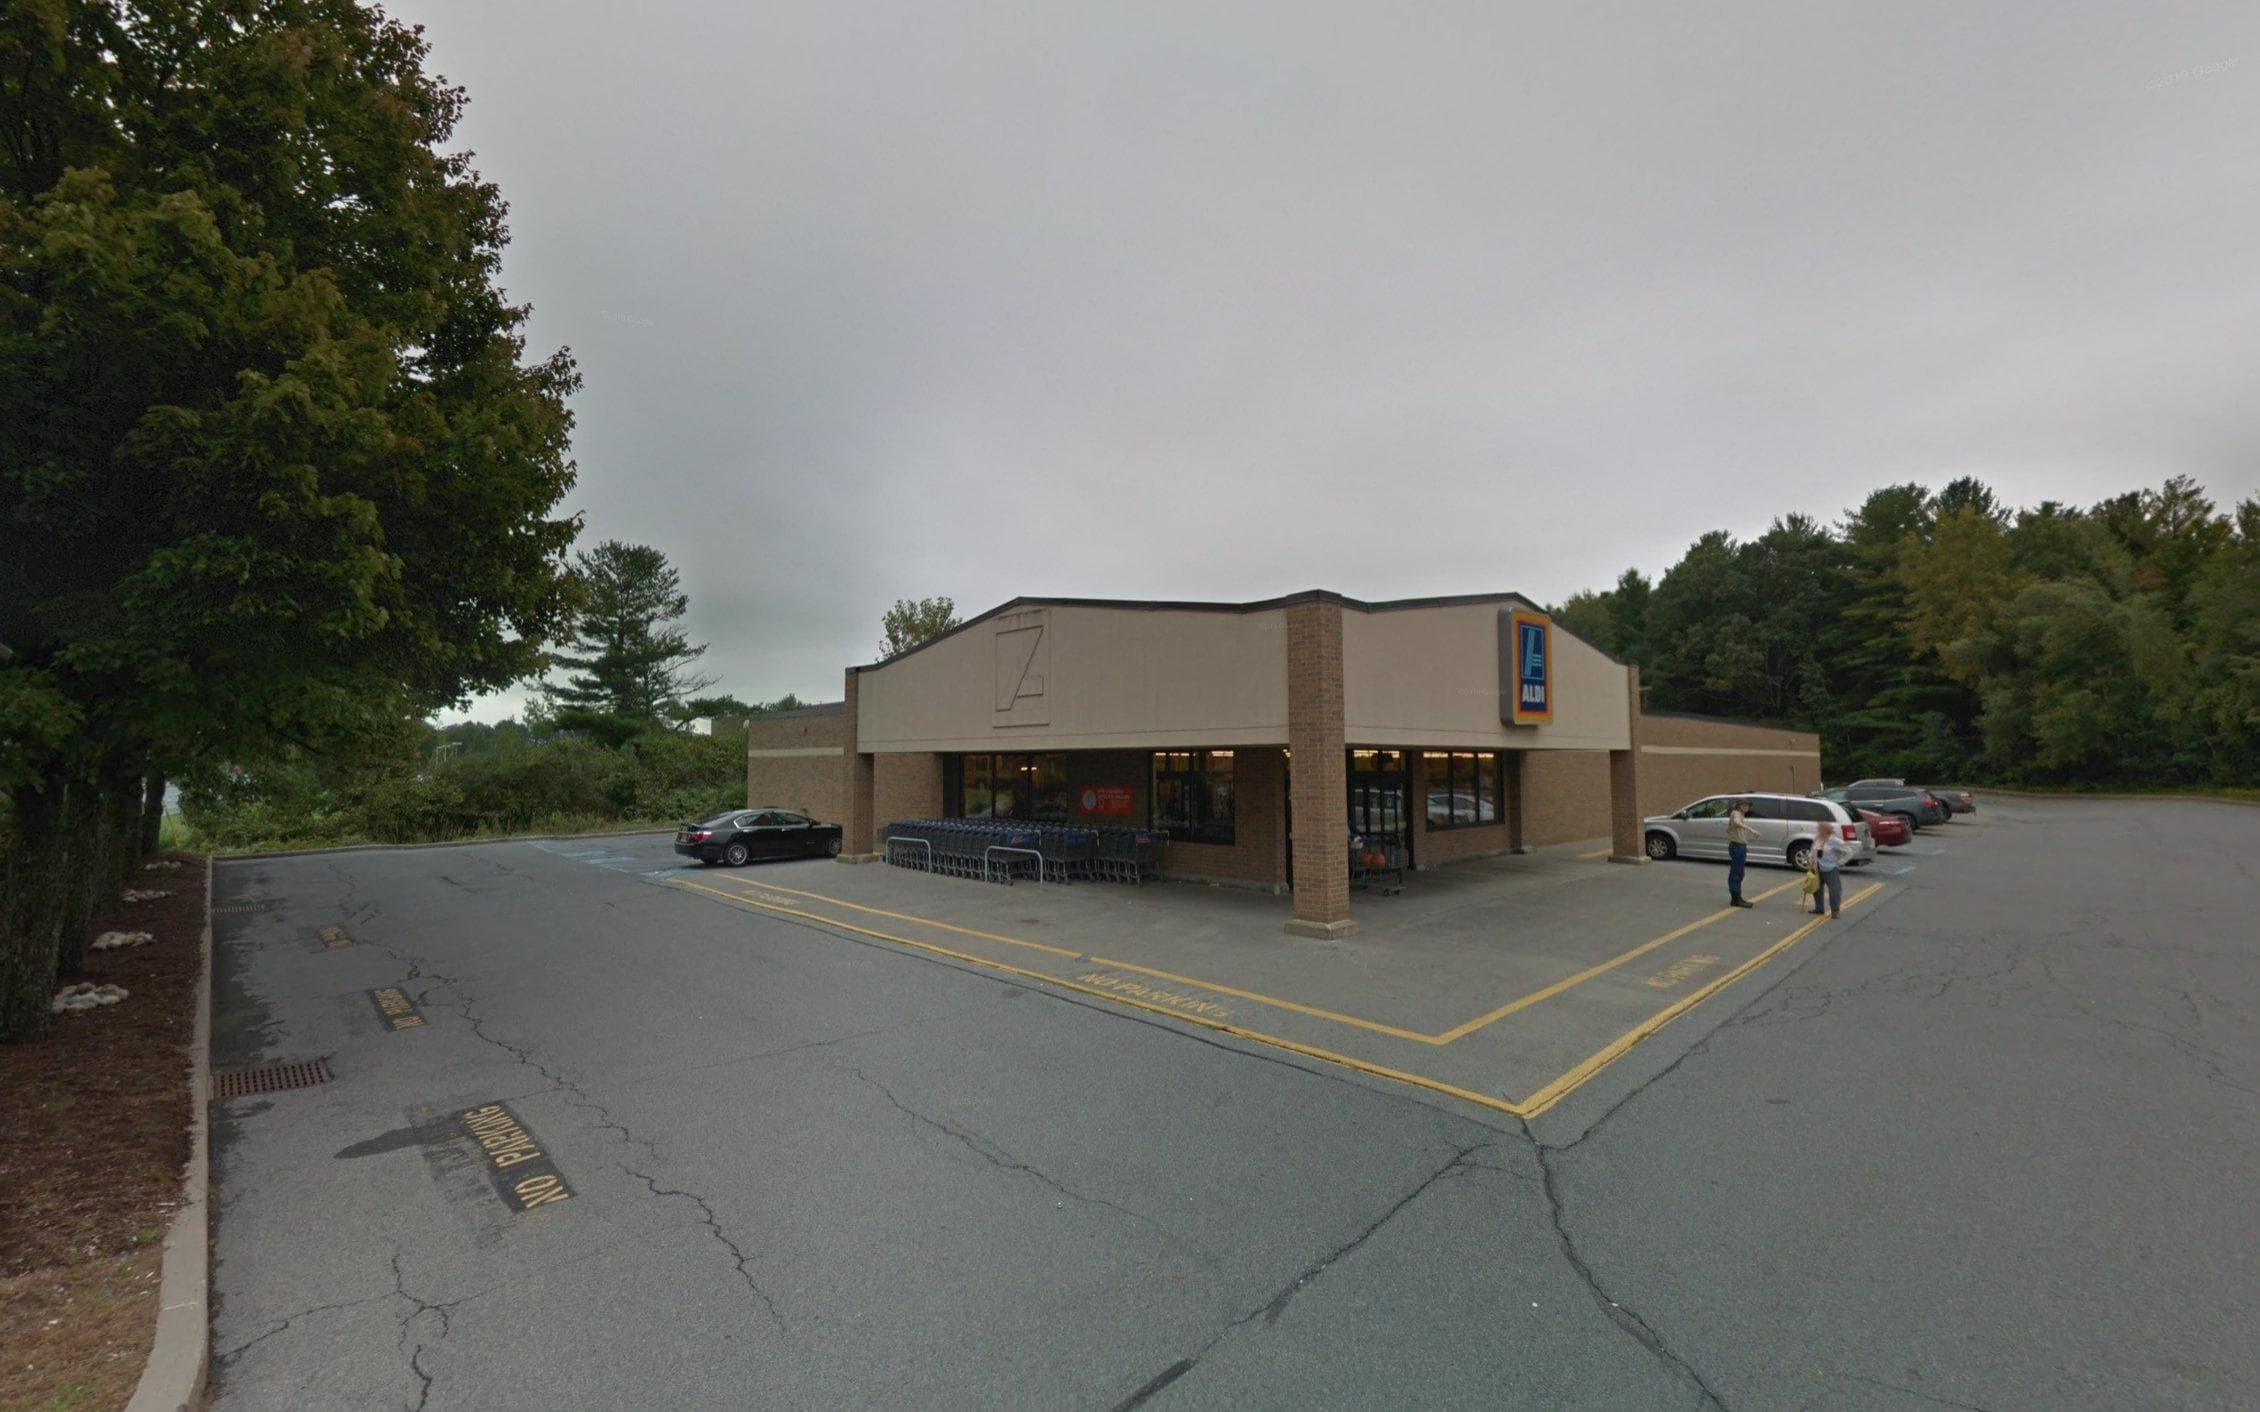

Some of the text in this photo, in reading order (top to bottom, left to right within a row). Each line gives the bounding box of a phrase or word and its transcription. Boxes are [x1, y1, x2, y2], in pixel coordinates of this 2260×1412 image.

[1521, 683, 1546, 704] ALDI
[1078, 973, 1119, 986] NO
[464, 1105, 569, 1209] NO PARKING
